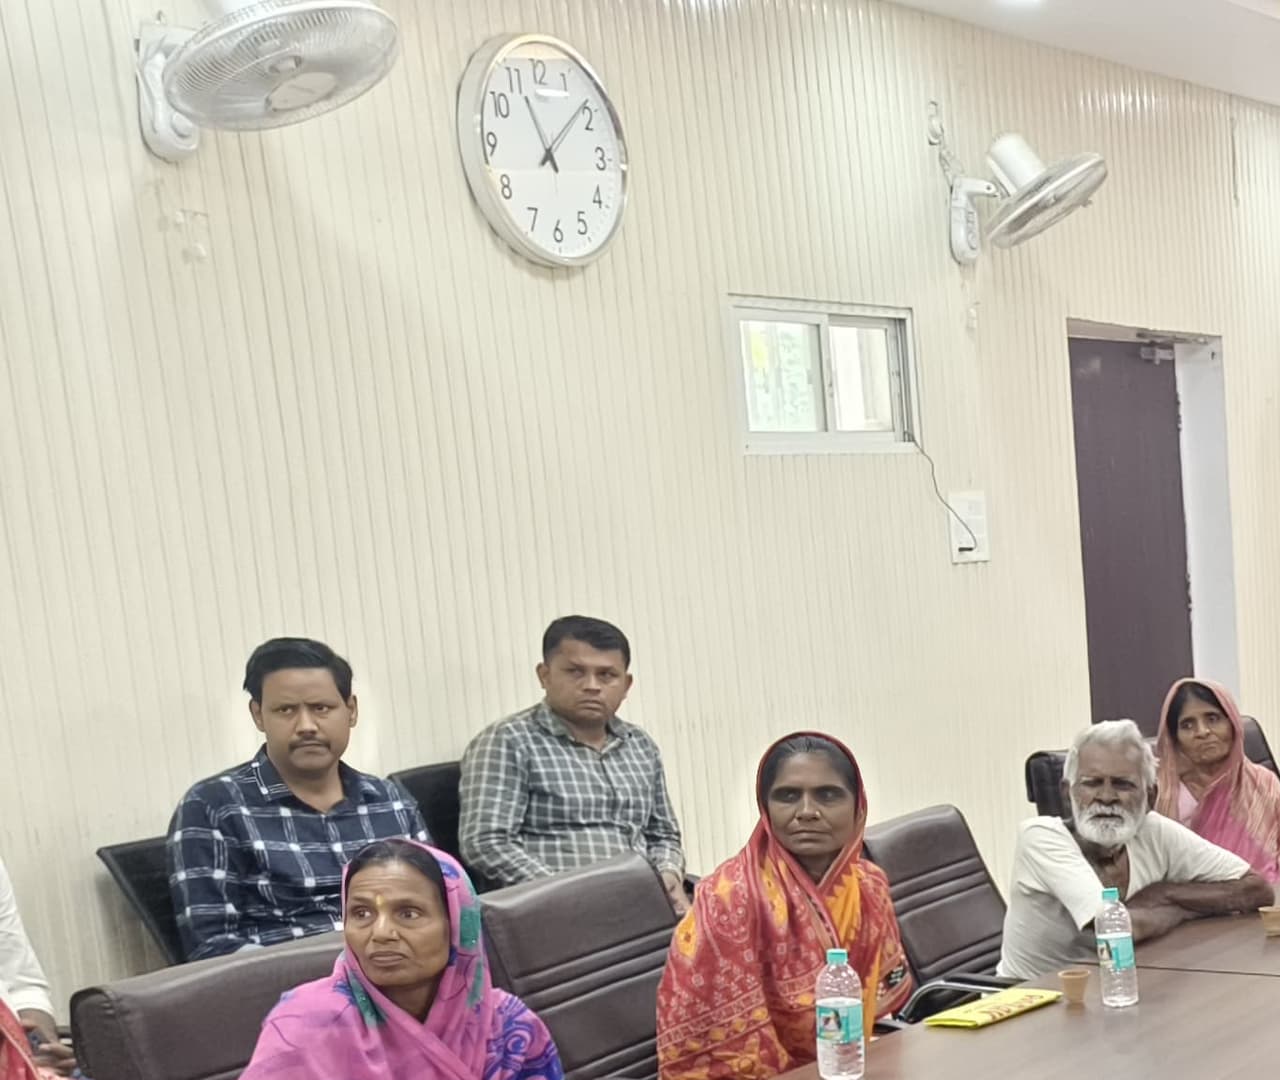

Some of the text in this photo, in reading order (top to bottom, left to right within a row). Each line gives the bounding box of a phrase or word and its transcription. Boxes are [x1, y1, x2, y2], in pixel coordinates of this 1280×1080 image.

[506, 66, 522, 94] 11
[529, 58, 548, 86] 12
[560, 73, 568, 91] 1
[490, 91, 510, 119] 10
[582, 104, 594, 131] 2
[486, 131, 498, 156] 9
[595, 147, 607, 171] 3
[500, 174, 512, 200] 8
[593, 184, 603, 209] 4
[527, 207, 539, 232] 7
[553, 219, 564, 243] 6
[577, 211, 588, 235] 5
